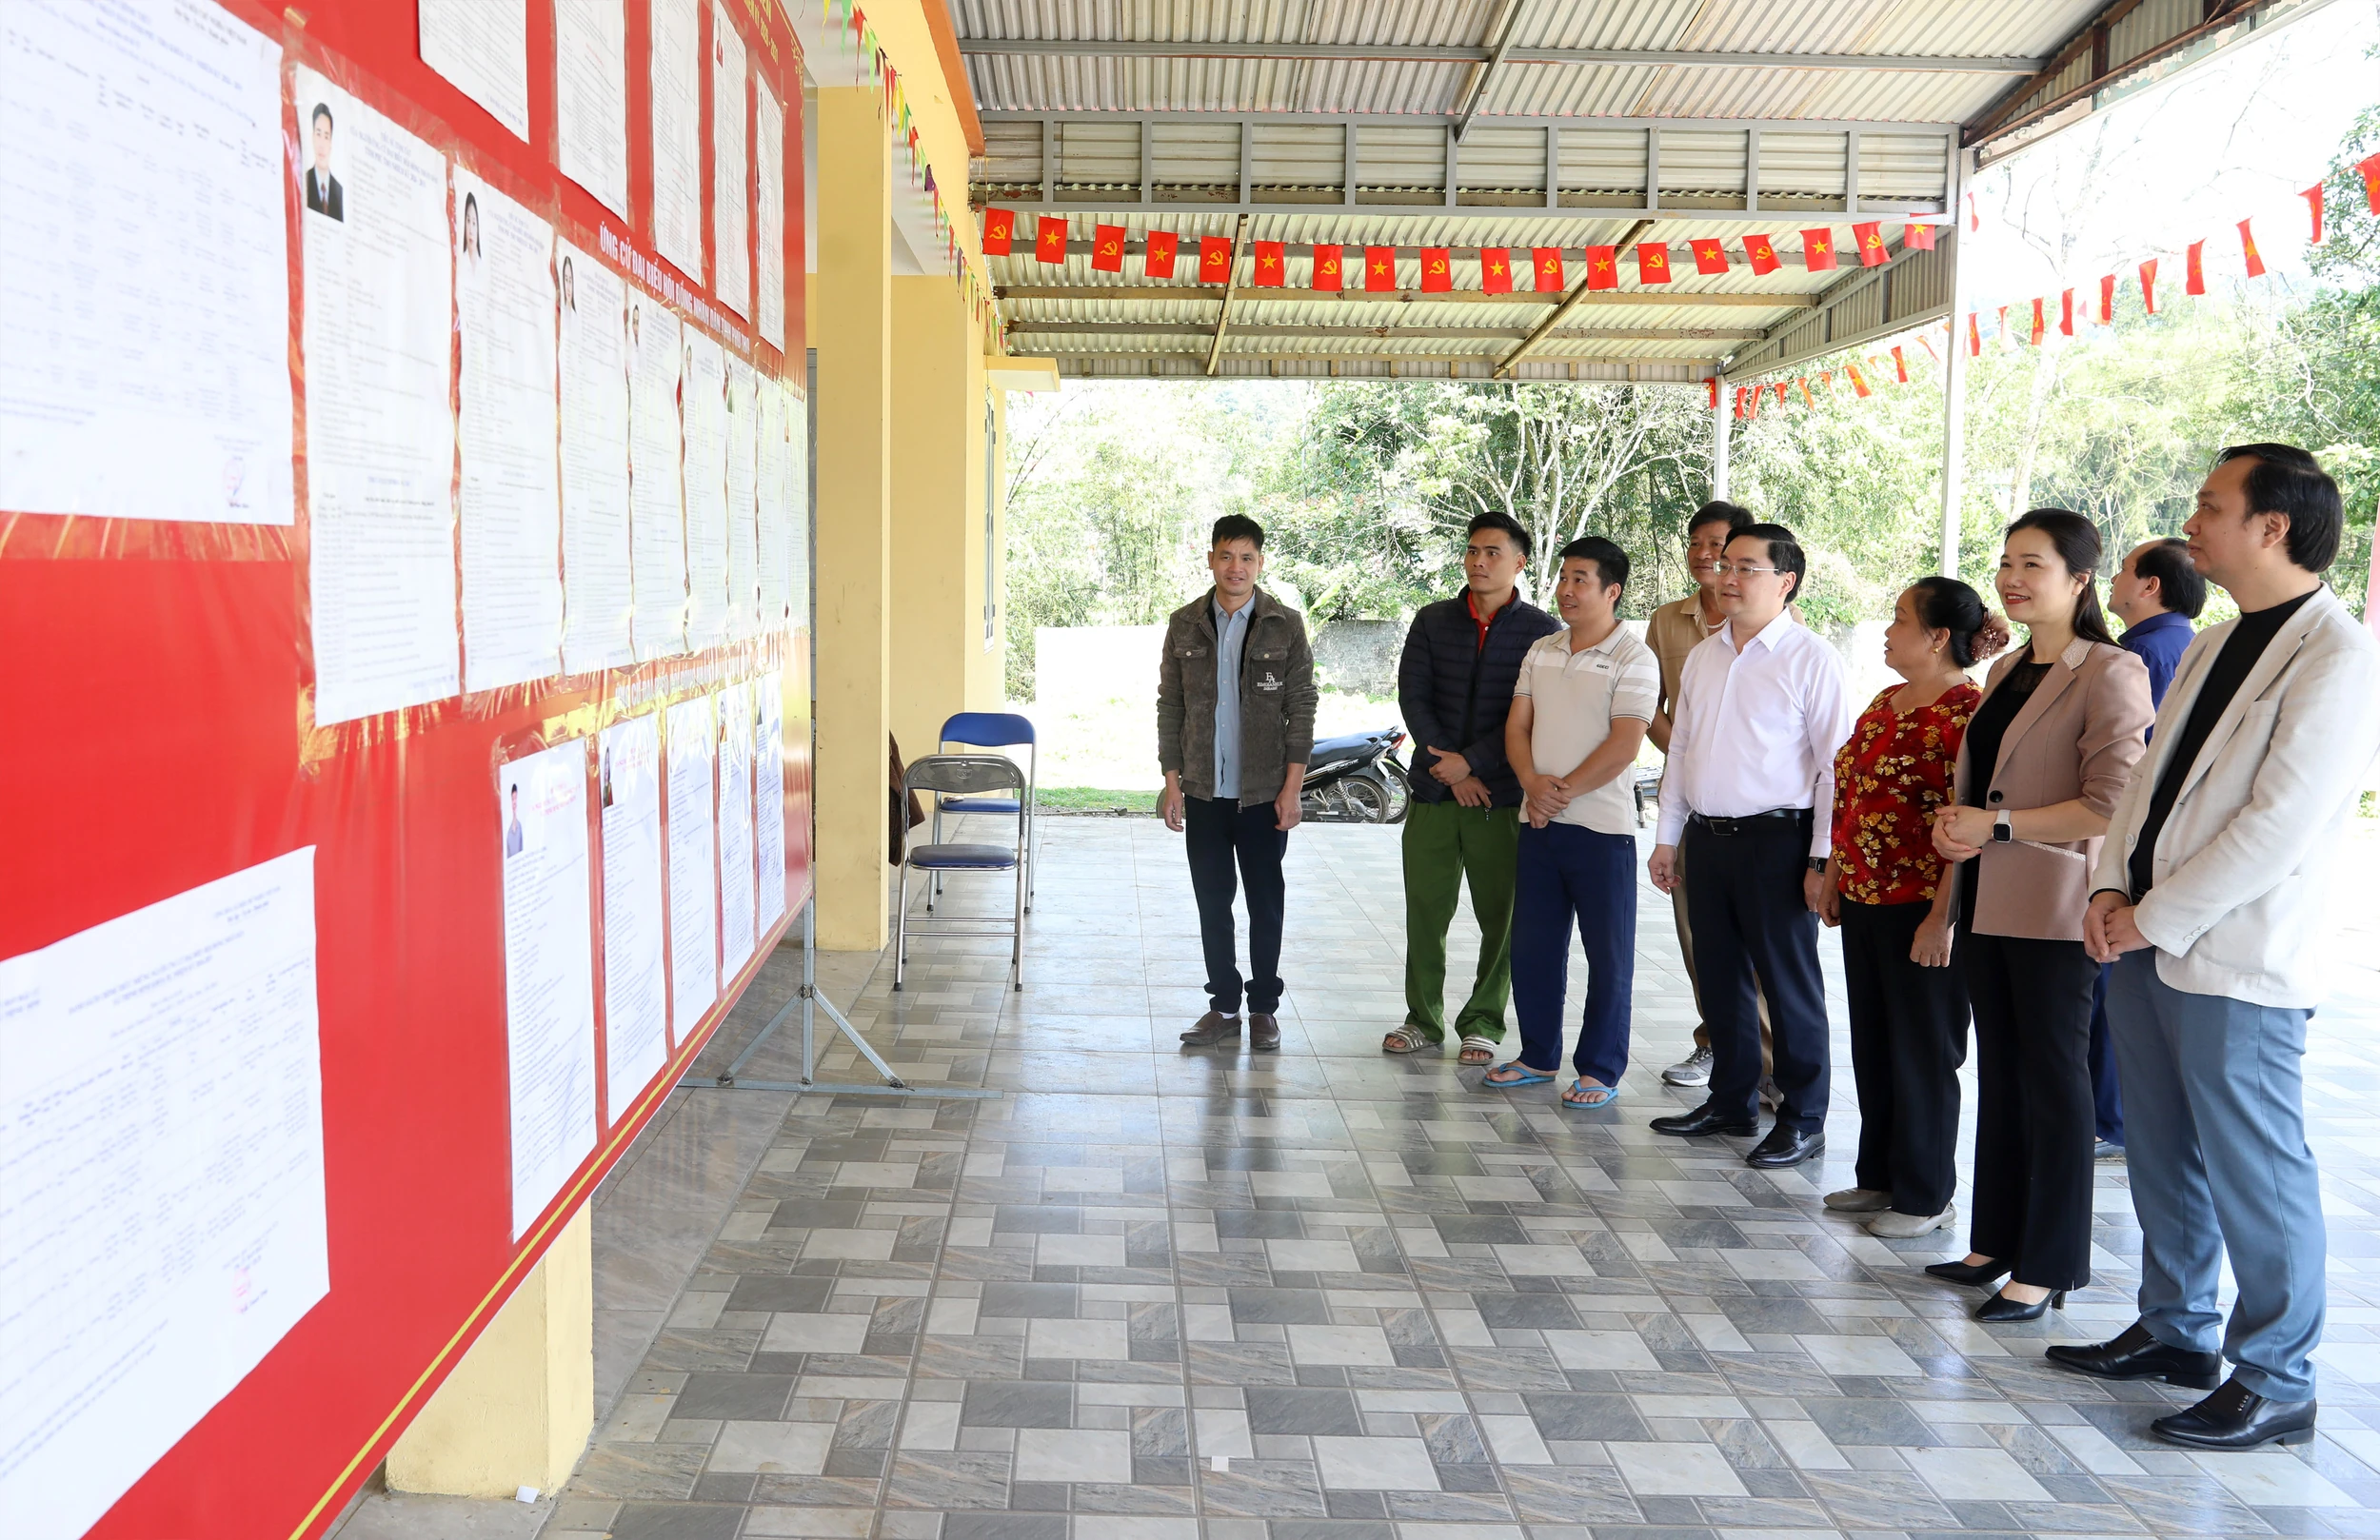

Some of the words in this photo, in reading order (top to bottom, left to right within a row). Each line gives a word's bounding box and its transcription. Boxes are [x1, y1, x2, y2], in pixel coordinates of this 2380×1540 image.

[600, 220, 619, 262] ỨNG
[619, 236, 632, 270] CỬ
[632, 249, 645, 283] ĐẠI
[645, 258, 663, 295] BIỂU
